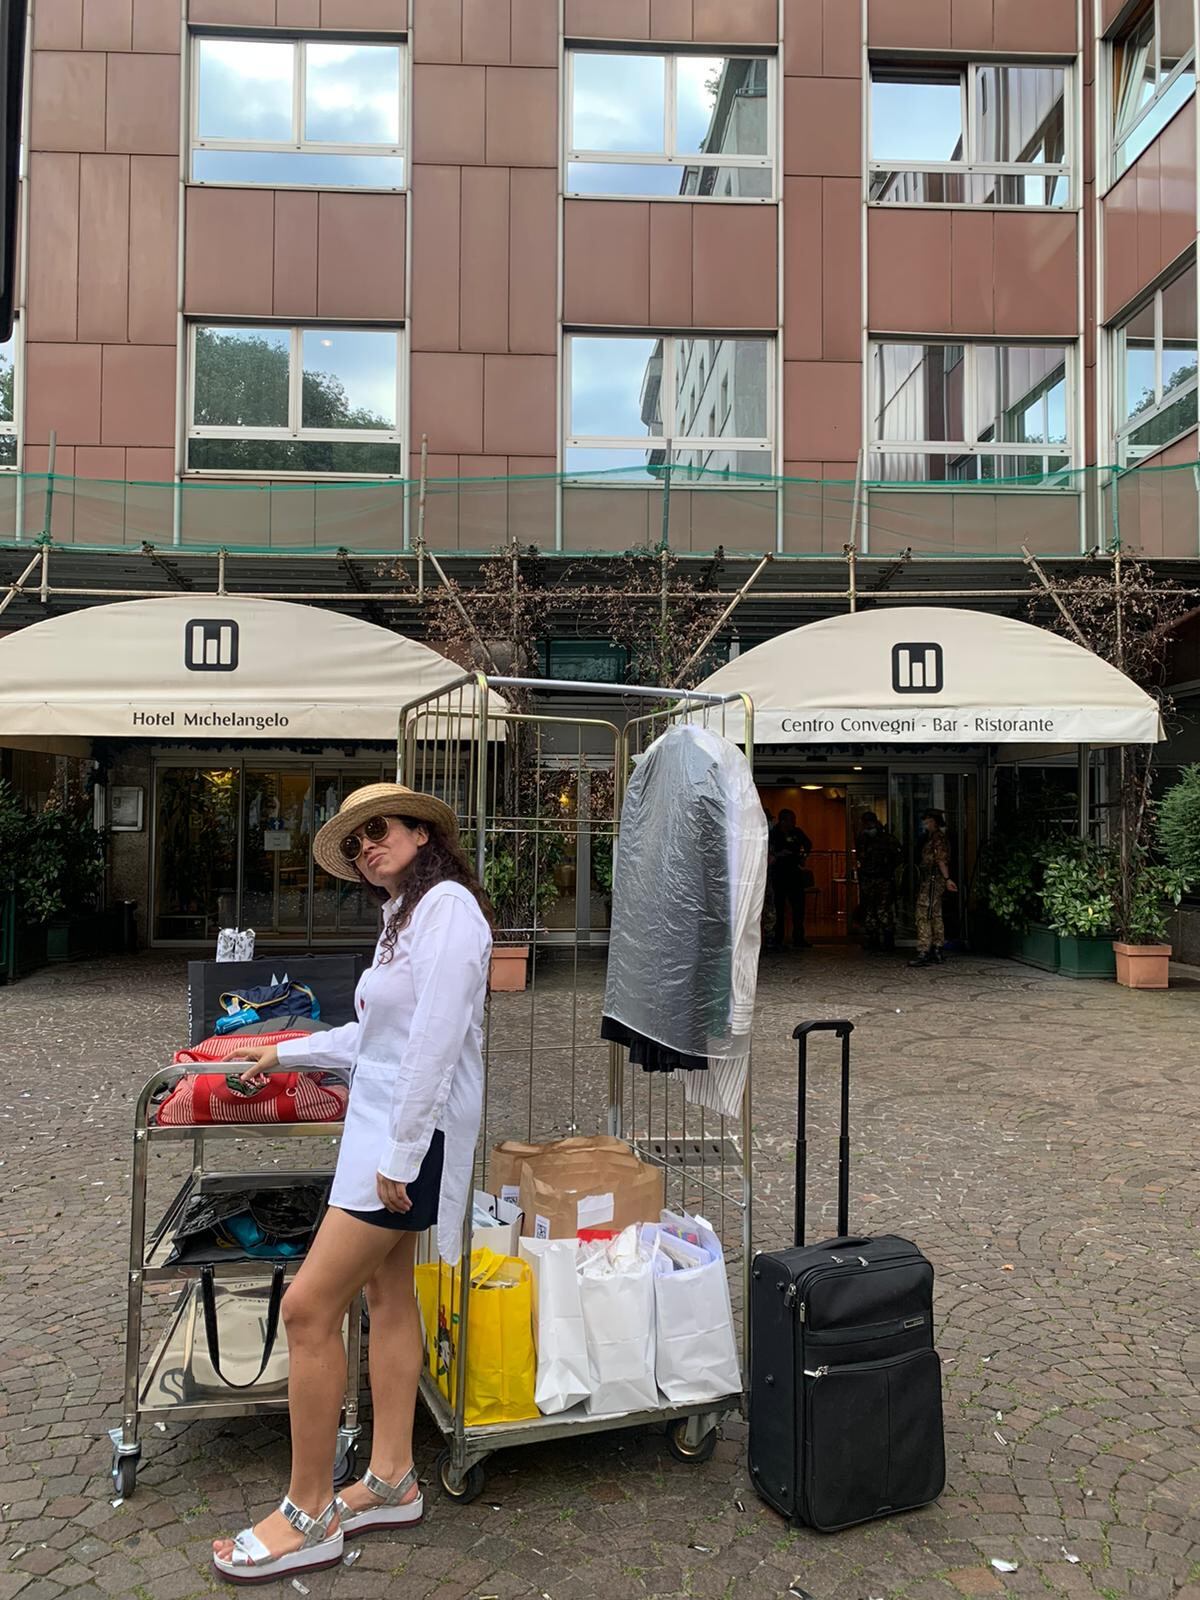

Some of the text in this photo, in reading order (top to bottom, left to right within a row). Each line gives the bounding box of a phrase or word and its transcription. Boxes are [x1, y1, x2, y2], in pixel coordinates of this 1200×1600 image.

[133, 711, 289, 731] Hotel Michelangelo
[781, 718, 835, 733] Centro
[840, 718, 915, 735] Convegni
[933, 718, 958, 732] Bar
[975, 717, 1054, 732] Ristorante
